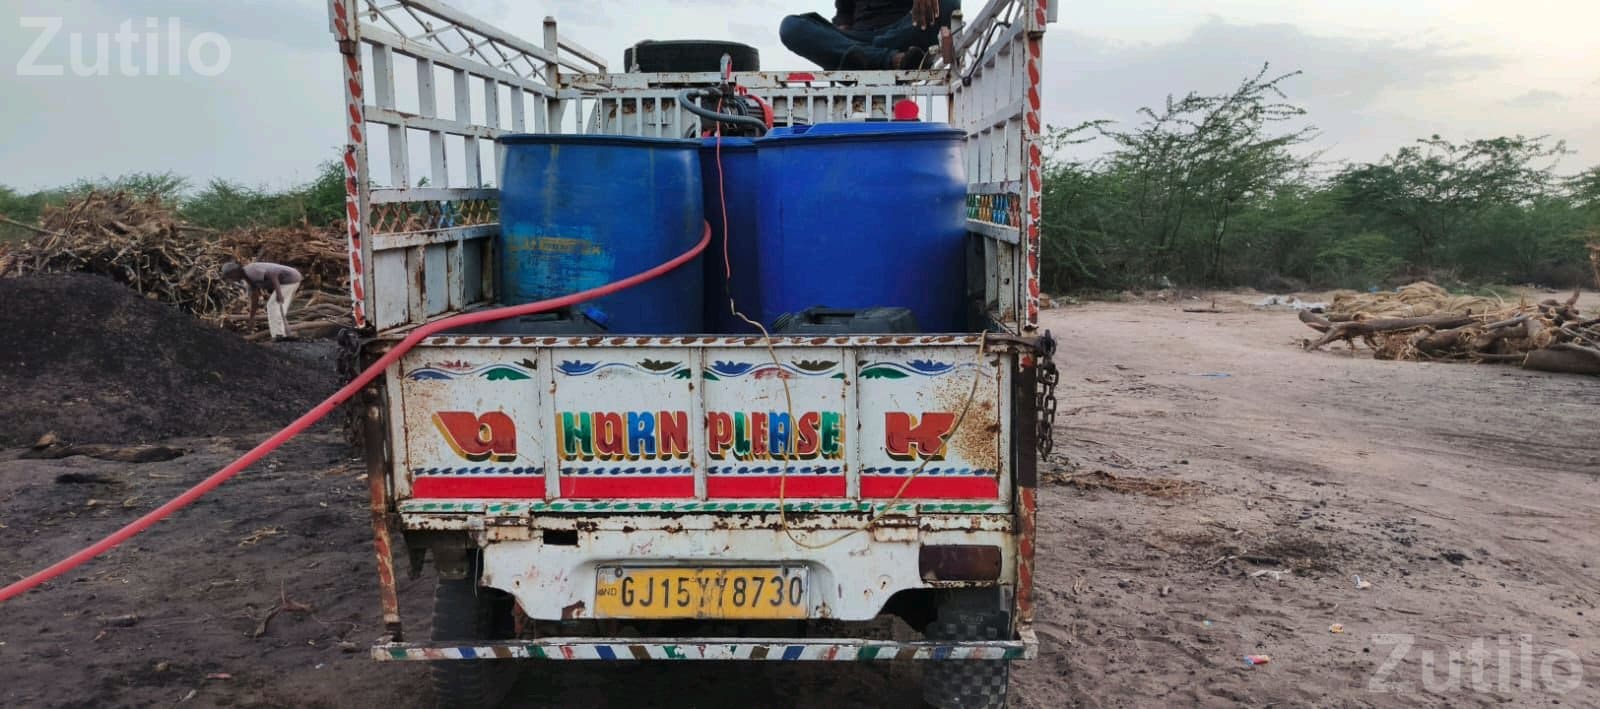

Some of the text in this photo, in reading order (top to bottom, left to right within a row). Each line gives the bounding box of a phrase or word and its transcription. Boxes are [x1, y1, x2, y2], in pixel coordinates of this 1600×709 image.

[555, 411, 690, 462] HORN
[707, 411, 845, 461] PLEASE
[621, 576, 804, 608] GJ15YY8730
